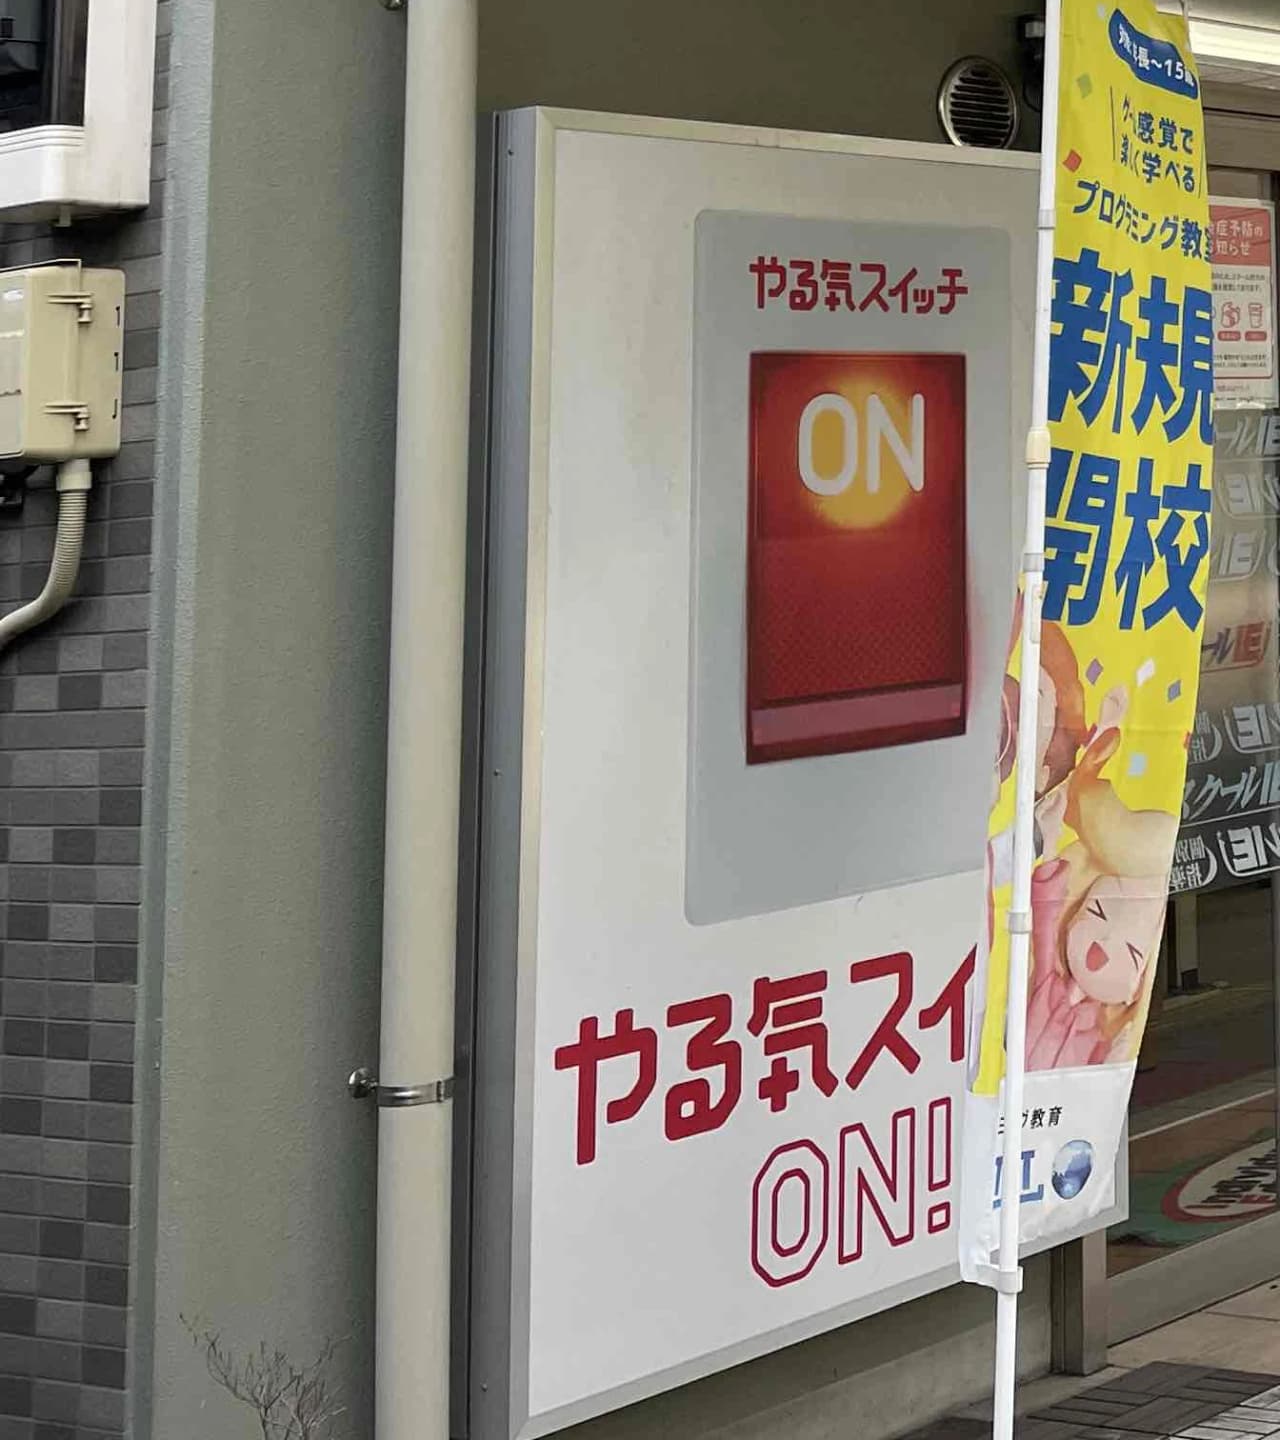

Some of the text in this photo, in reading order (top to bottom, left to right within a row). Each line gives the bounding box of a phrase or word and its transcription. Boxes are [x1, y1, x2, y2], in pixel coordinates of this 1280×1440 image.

[750, 256, 969, 314] やる気スイッチ
[1047, 248, 1214, 446] 新規
[797, 392, 926, 497] ON
[1044, 449, 1212, 632] 開校
[554, 943, 978, 1166] やる気スイ
[750, 1096, 952, 1288] ON!
